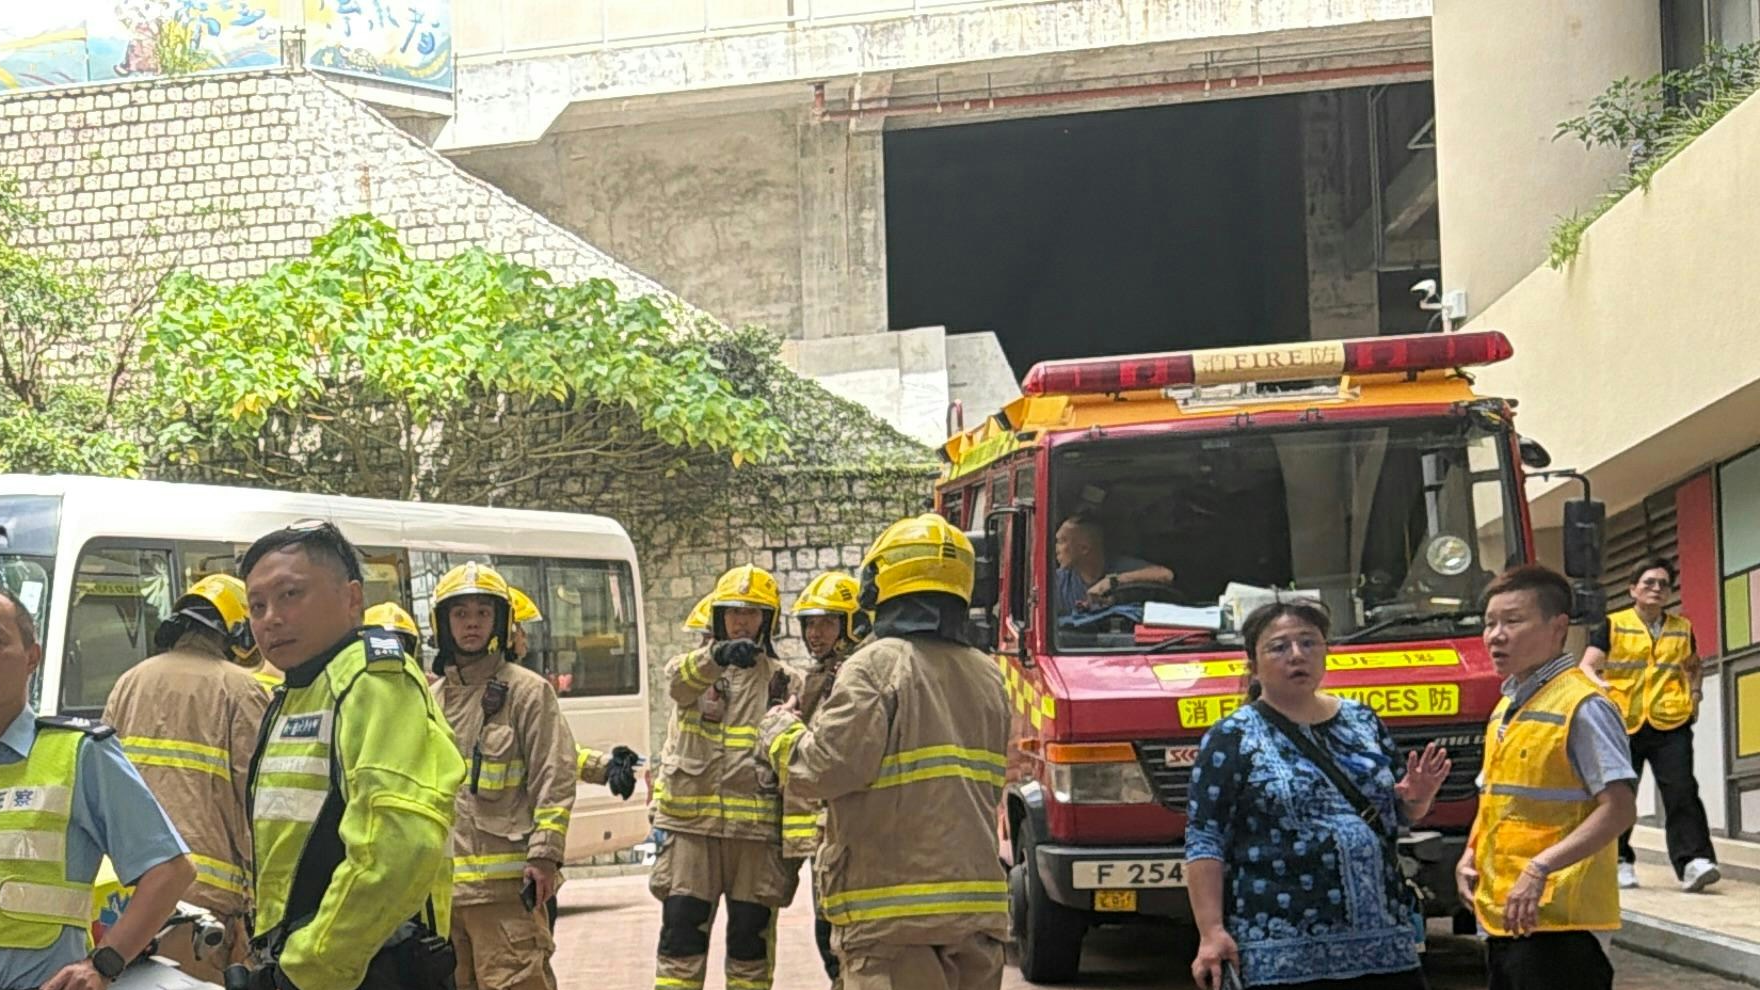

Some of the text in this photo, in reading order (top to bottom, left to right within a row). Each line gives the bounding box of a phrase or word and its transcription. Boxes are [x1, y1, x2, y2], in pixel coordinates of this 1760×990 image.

[1234, 349, 1305, 370] FIRE
[1185, 699, 1208, 724] 消
[1428, 687, 1452, 712] 防
[1097, 863, 1115, 885] F
